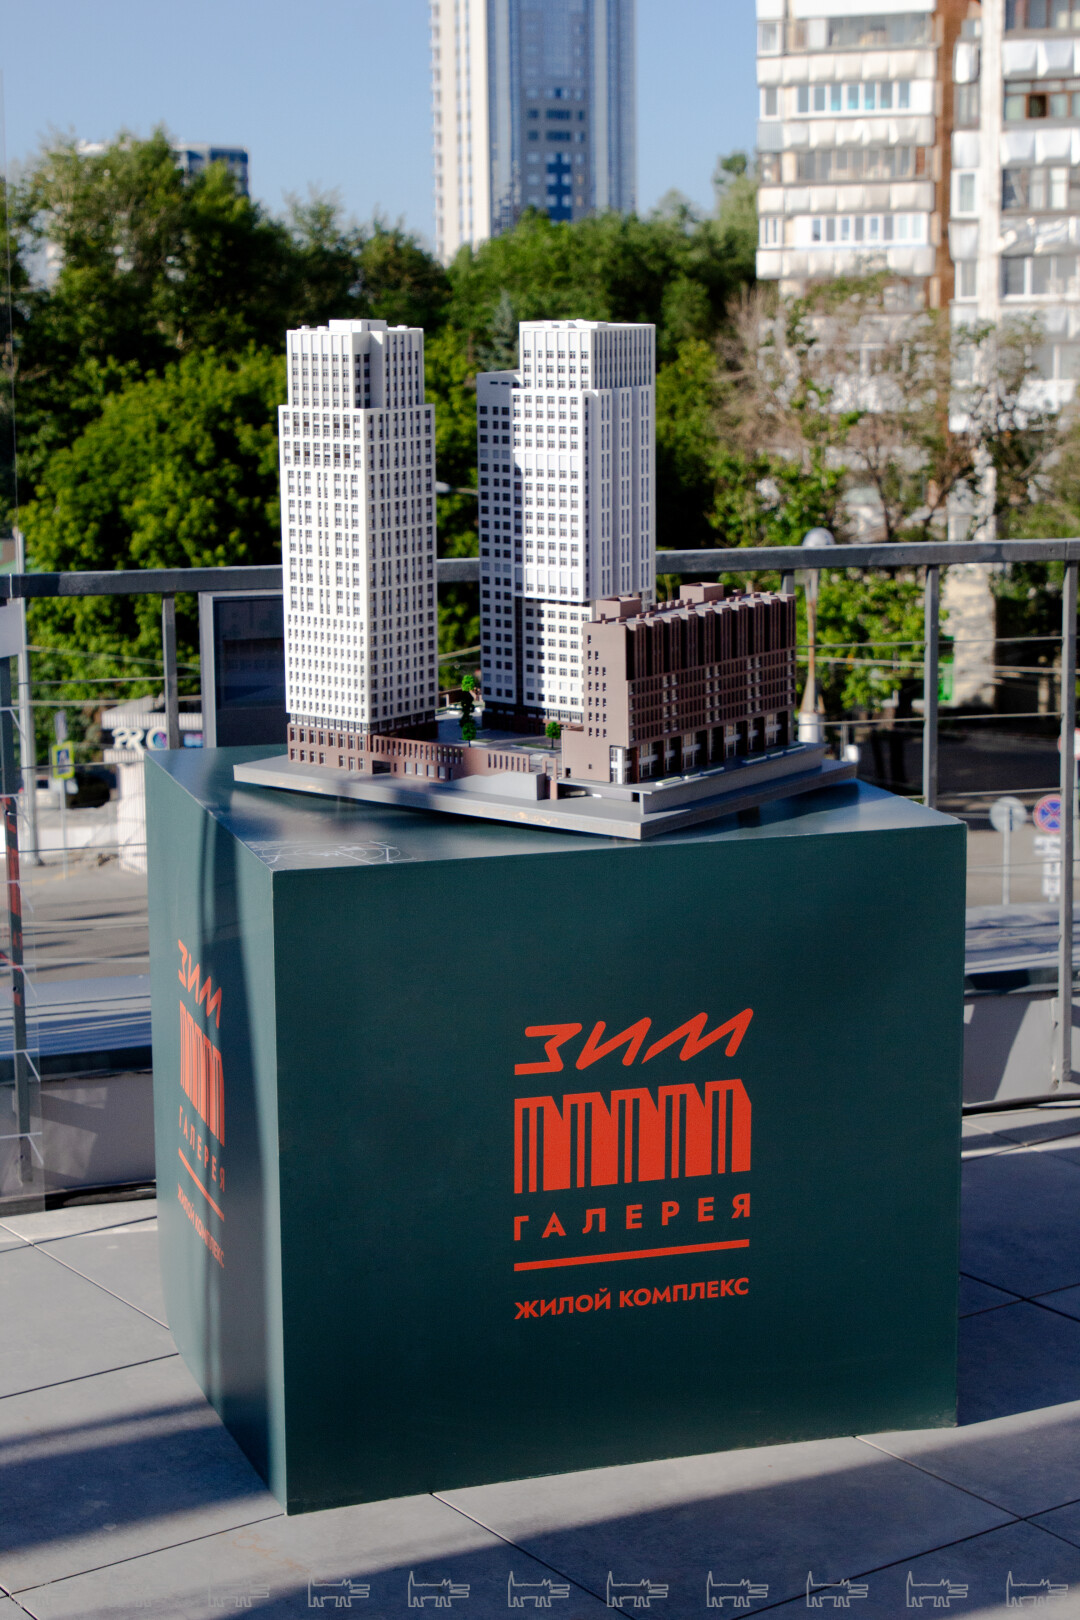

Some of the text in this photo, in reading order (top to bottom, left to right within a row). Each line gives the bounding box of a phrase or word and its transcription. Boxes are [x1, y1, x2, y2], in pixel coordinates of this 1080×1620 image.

[514, 1008, 753, 1075] ЗИМ
[179, 1105, 225, 1193] ГАЛЕРЕЯ
[514, 1193, 750, 1240] ГАЛЕРЕЯ
[514, 1278, 749, 1319] ЖИЛОЙ КОМПЛЕКС
